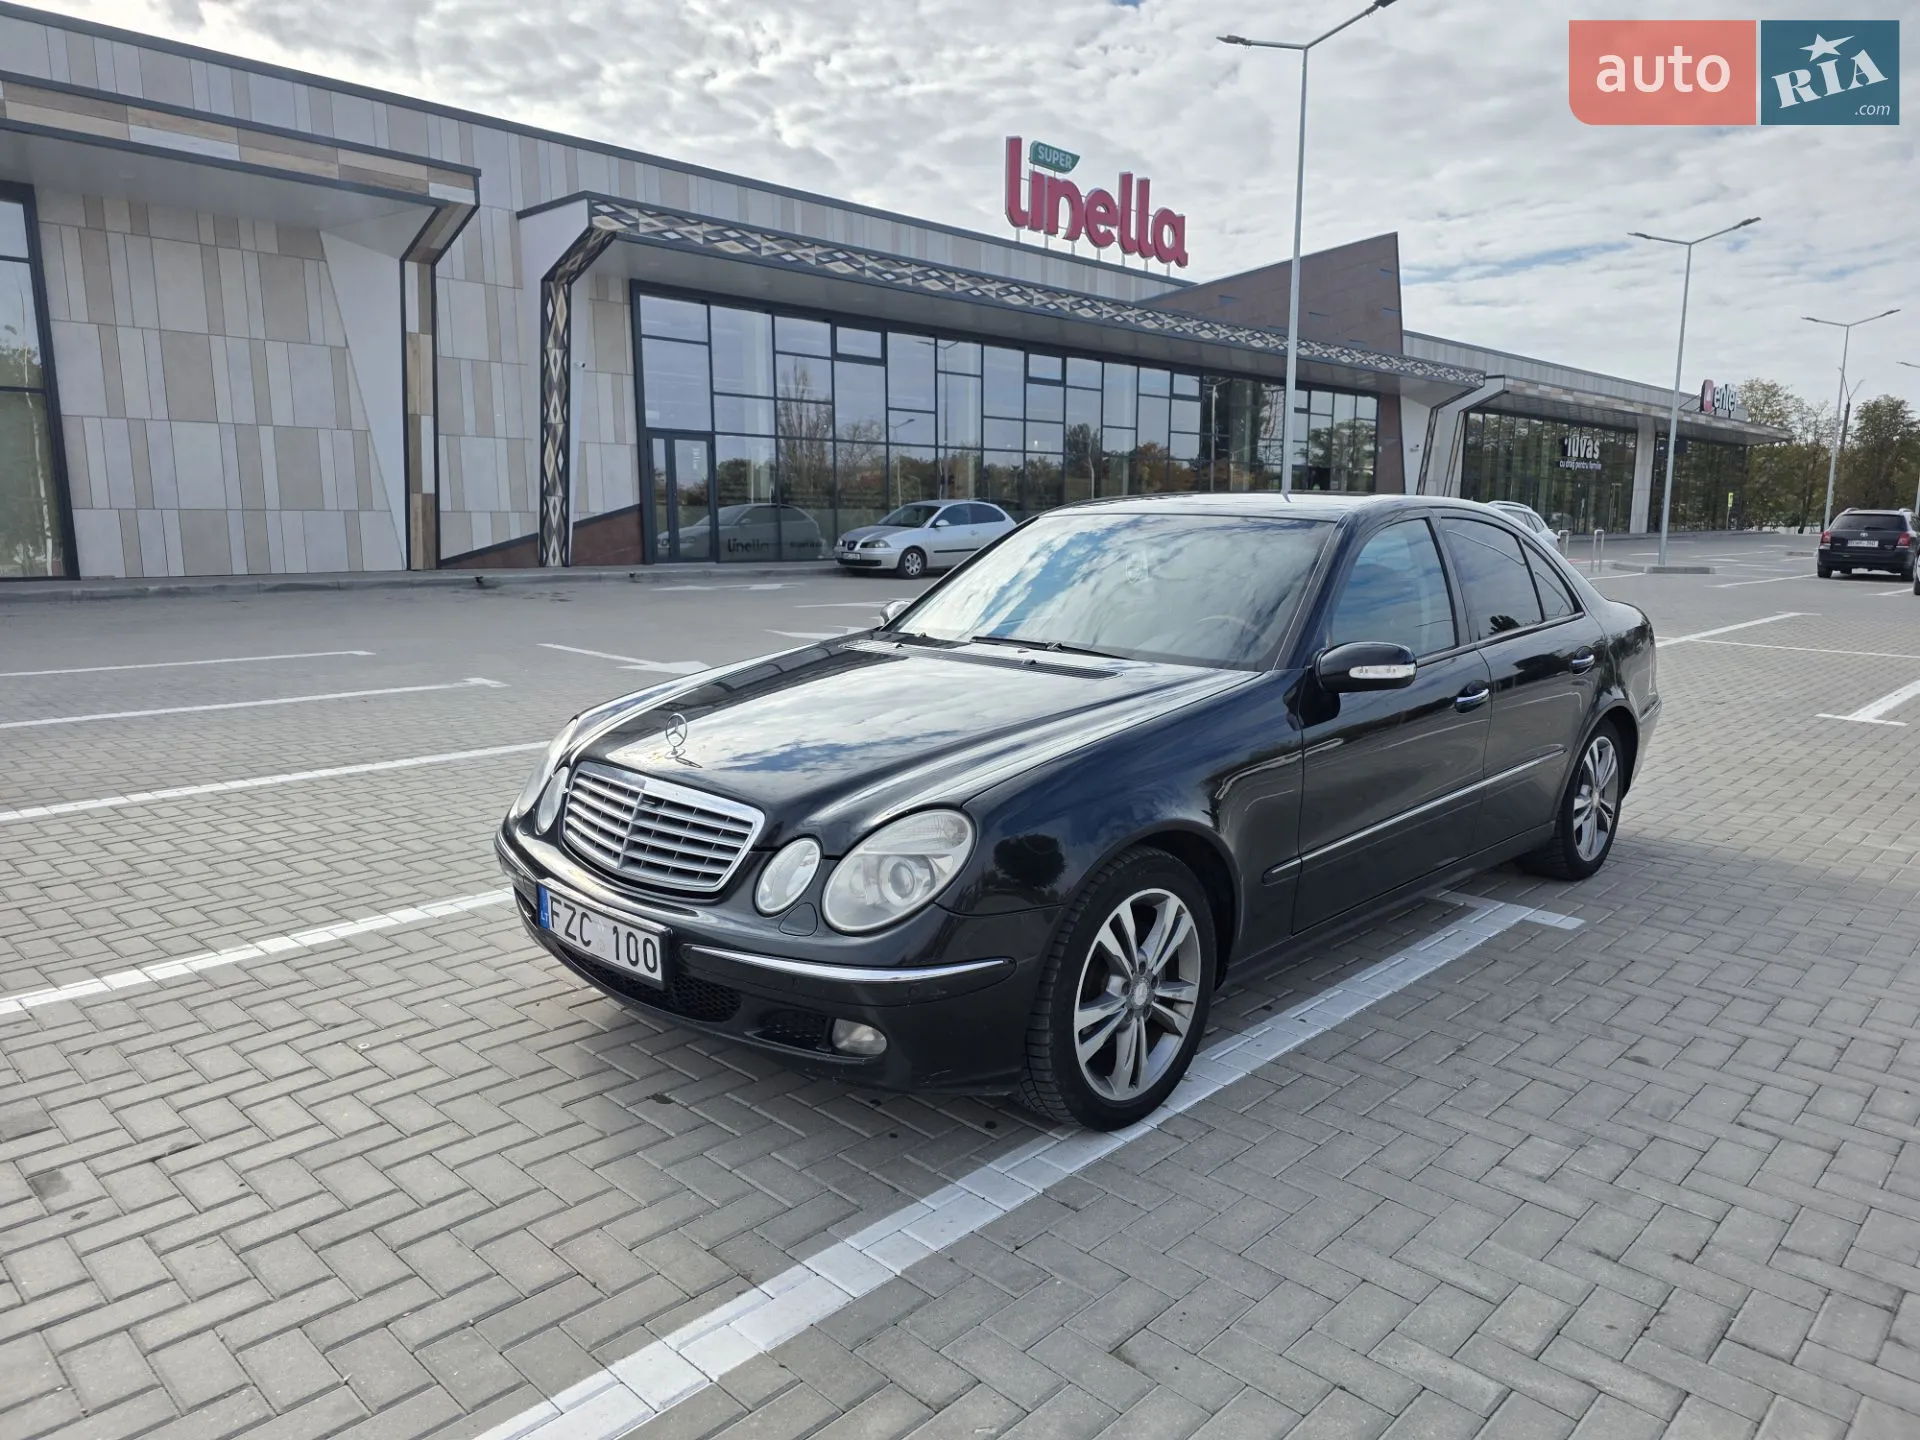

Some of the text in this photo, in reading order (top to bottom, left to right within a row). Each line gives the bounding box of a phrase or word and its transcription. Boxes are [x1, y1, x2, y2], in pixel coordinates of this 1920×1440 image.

[1037, 145, 1074, 169] SUPER
[540, 910, 549, 922] LT
[550, 895, 658, 974] FZC 100
